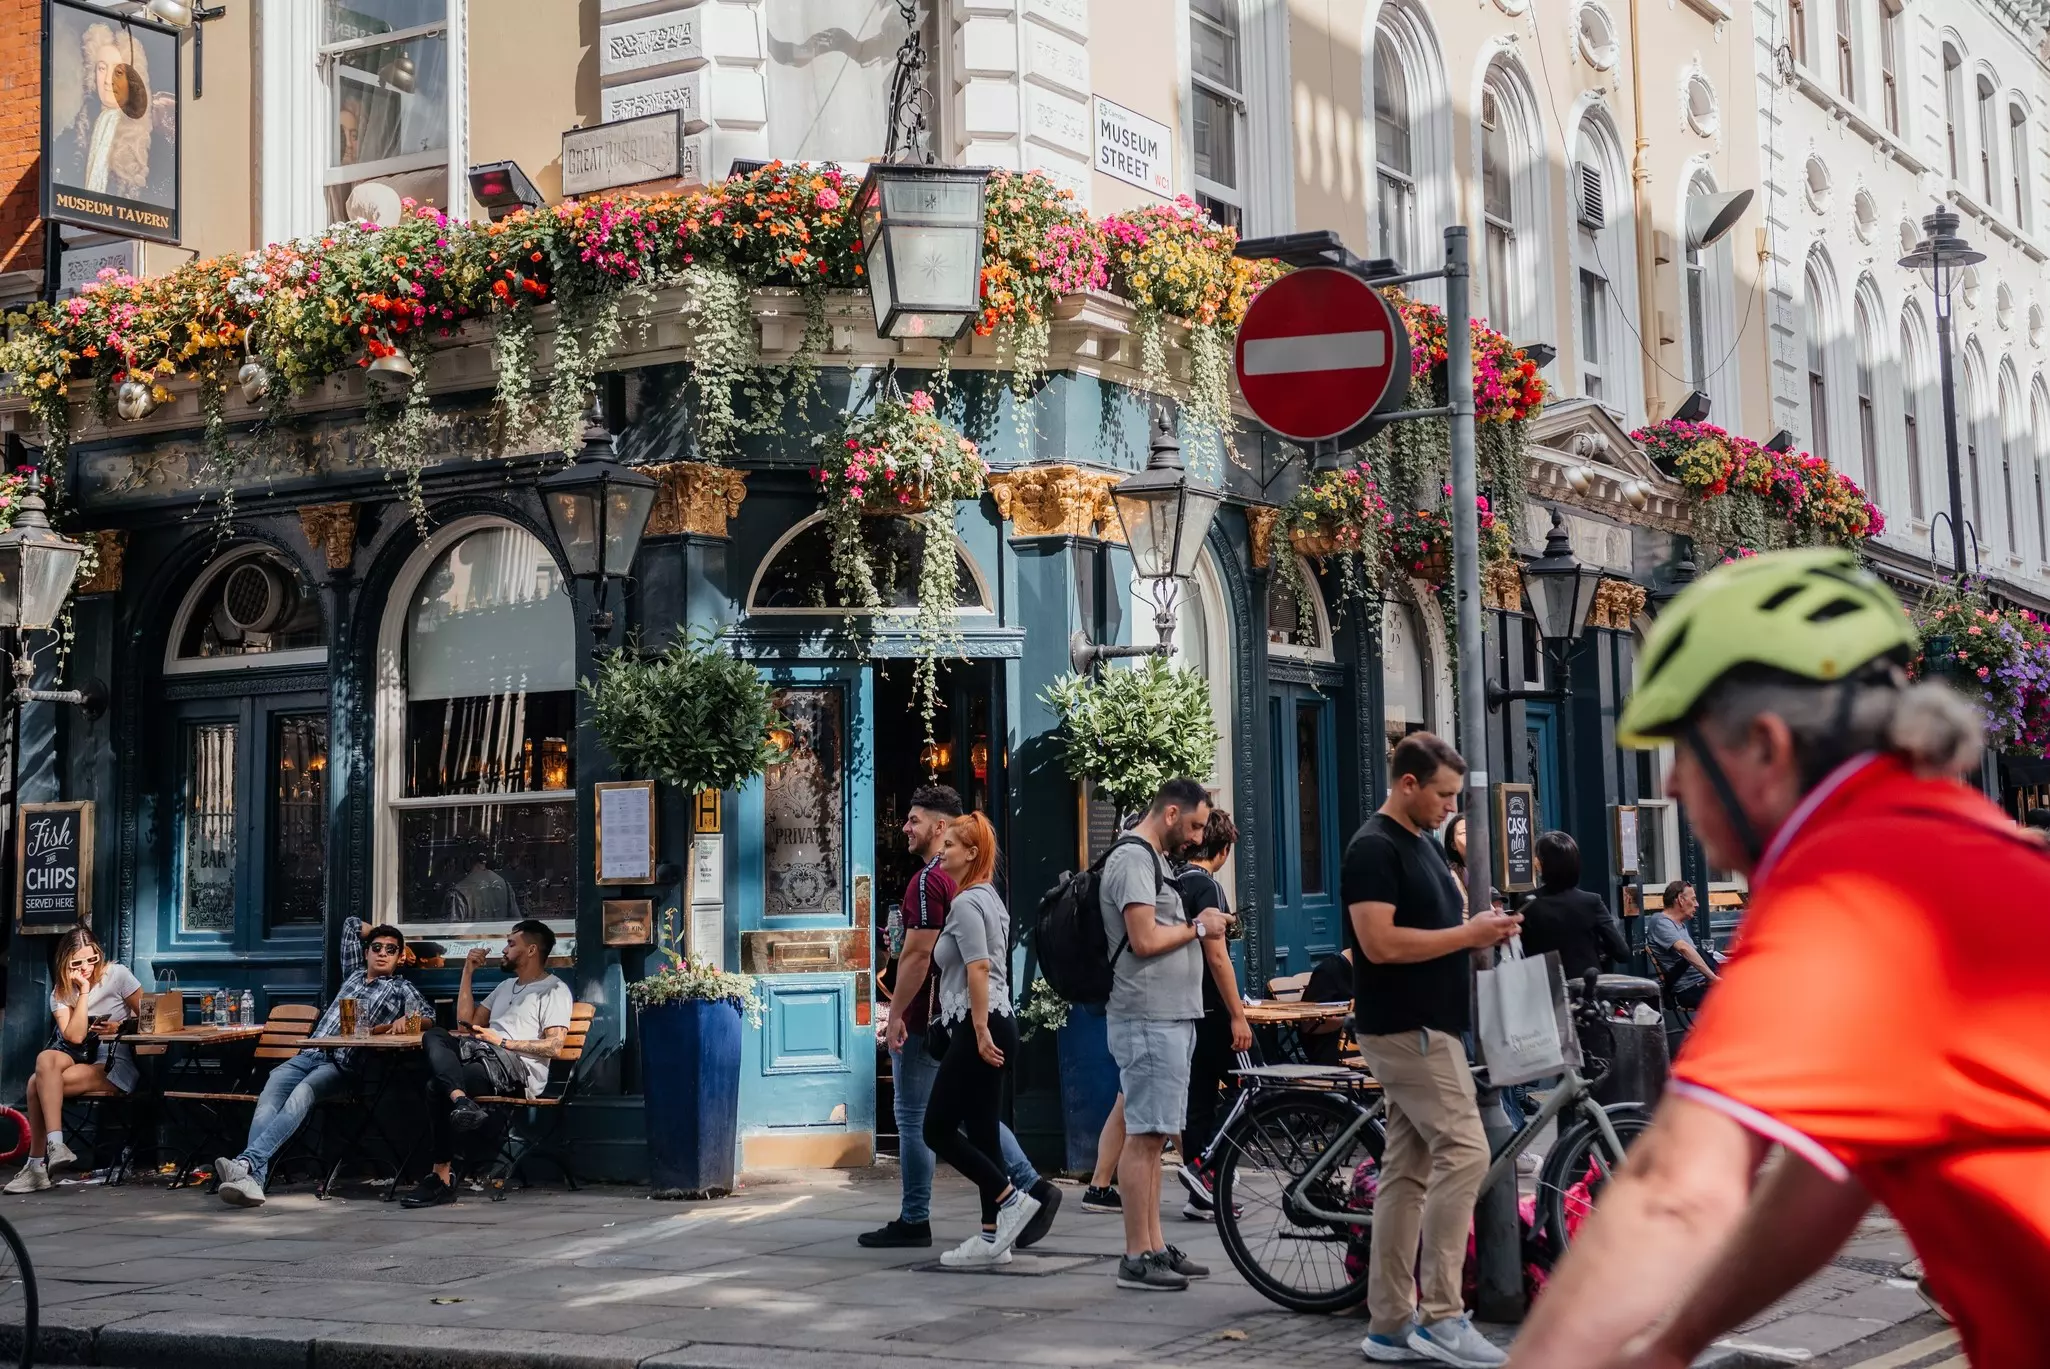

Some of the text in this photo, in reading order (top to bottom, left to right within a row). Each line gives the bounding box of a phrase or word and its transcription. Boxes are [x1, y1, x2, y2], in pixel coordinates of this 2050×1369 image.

[1101, 119, 1158, 160] MUSEUM
[568, 146, 603, 175] GREAT
[1101, 145, 1149, 180] STREET
[1155, 174, 1170, 190] WC1
[56, 193, 169, 229] MUSEUM TAVERN
[1507, 817, 1528, 835] CASK
[27, 817, 74, 857] Fish
[775, 827, 831, 845] PRIVATE
[1511, 833, 1526, 852] ales
[46, 854, 57, 863] AND
[200, 850, 227, 869] BAR
[26, 867, 76, 890] CHIPS
[25, 897, 75, 909] SERVED HERE
